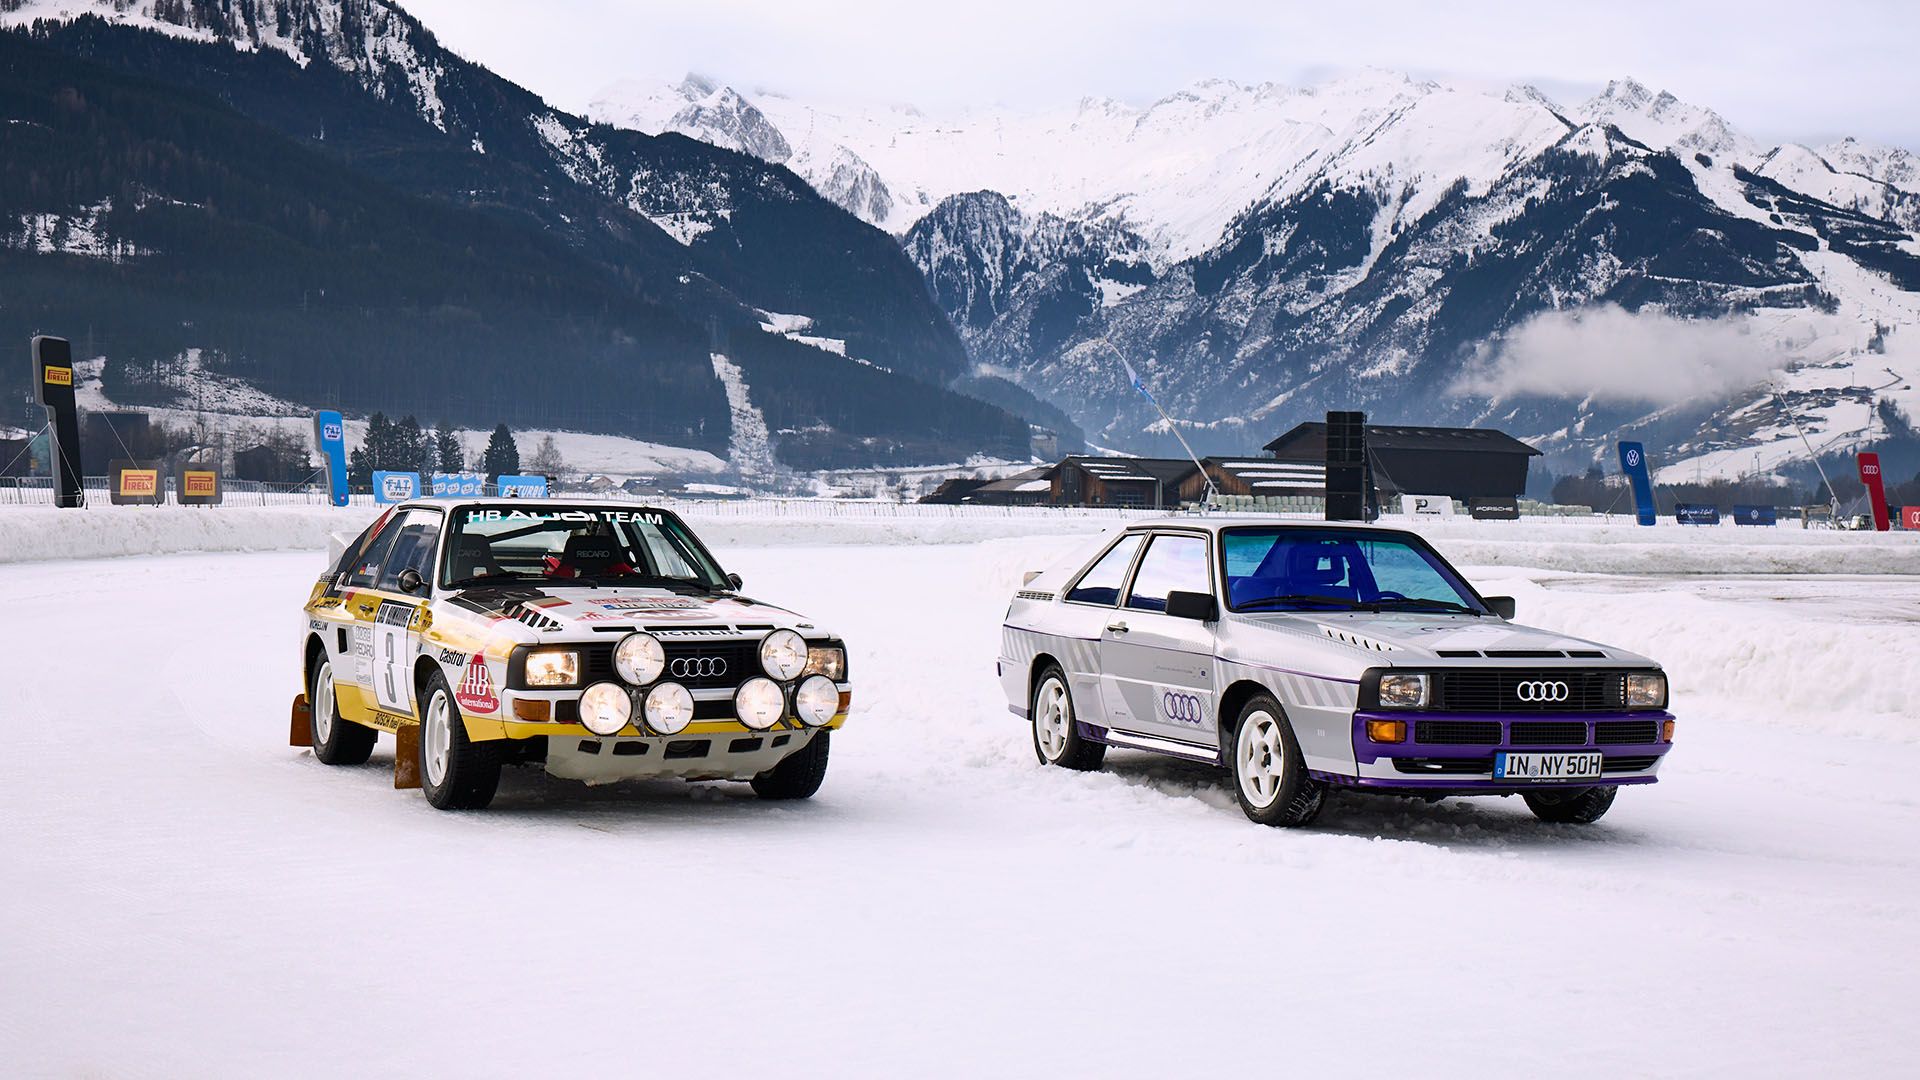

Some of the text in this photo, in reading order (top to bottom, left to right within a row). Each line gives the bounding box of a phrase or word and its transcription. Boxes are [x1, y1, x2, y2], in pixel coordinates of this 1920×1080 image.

[47, 369, 69, 382] PIRELLI
[123, 474, 154, 491] PIRELLI
[187, 476, 213, 491] PIRELLI
[468, 510, 502, 523] HB
[600, 511, 663, 525] TEAM
[576, 550, 611, 558] RECARO
[439, 648, 467, 667] Castrol
[385, 632, 397, 704] 3
[465, 663, 489, 696] HB
[460, 696, 494, 710] international
[1506, 755, 1600, 775] IN NY 50H
